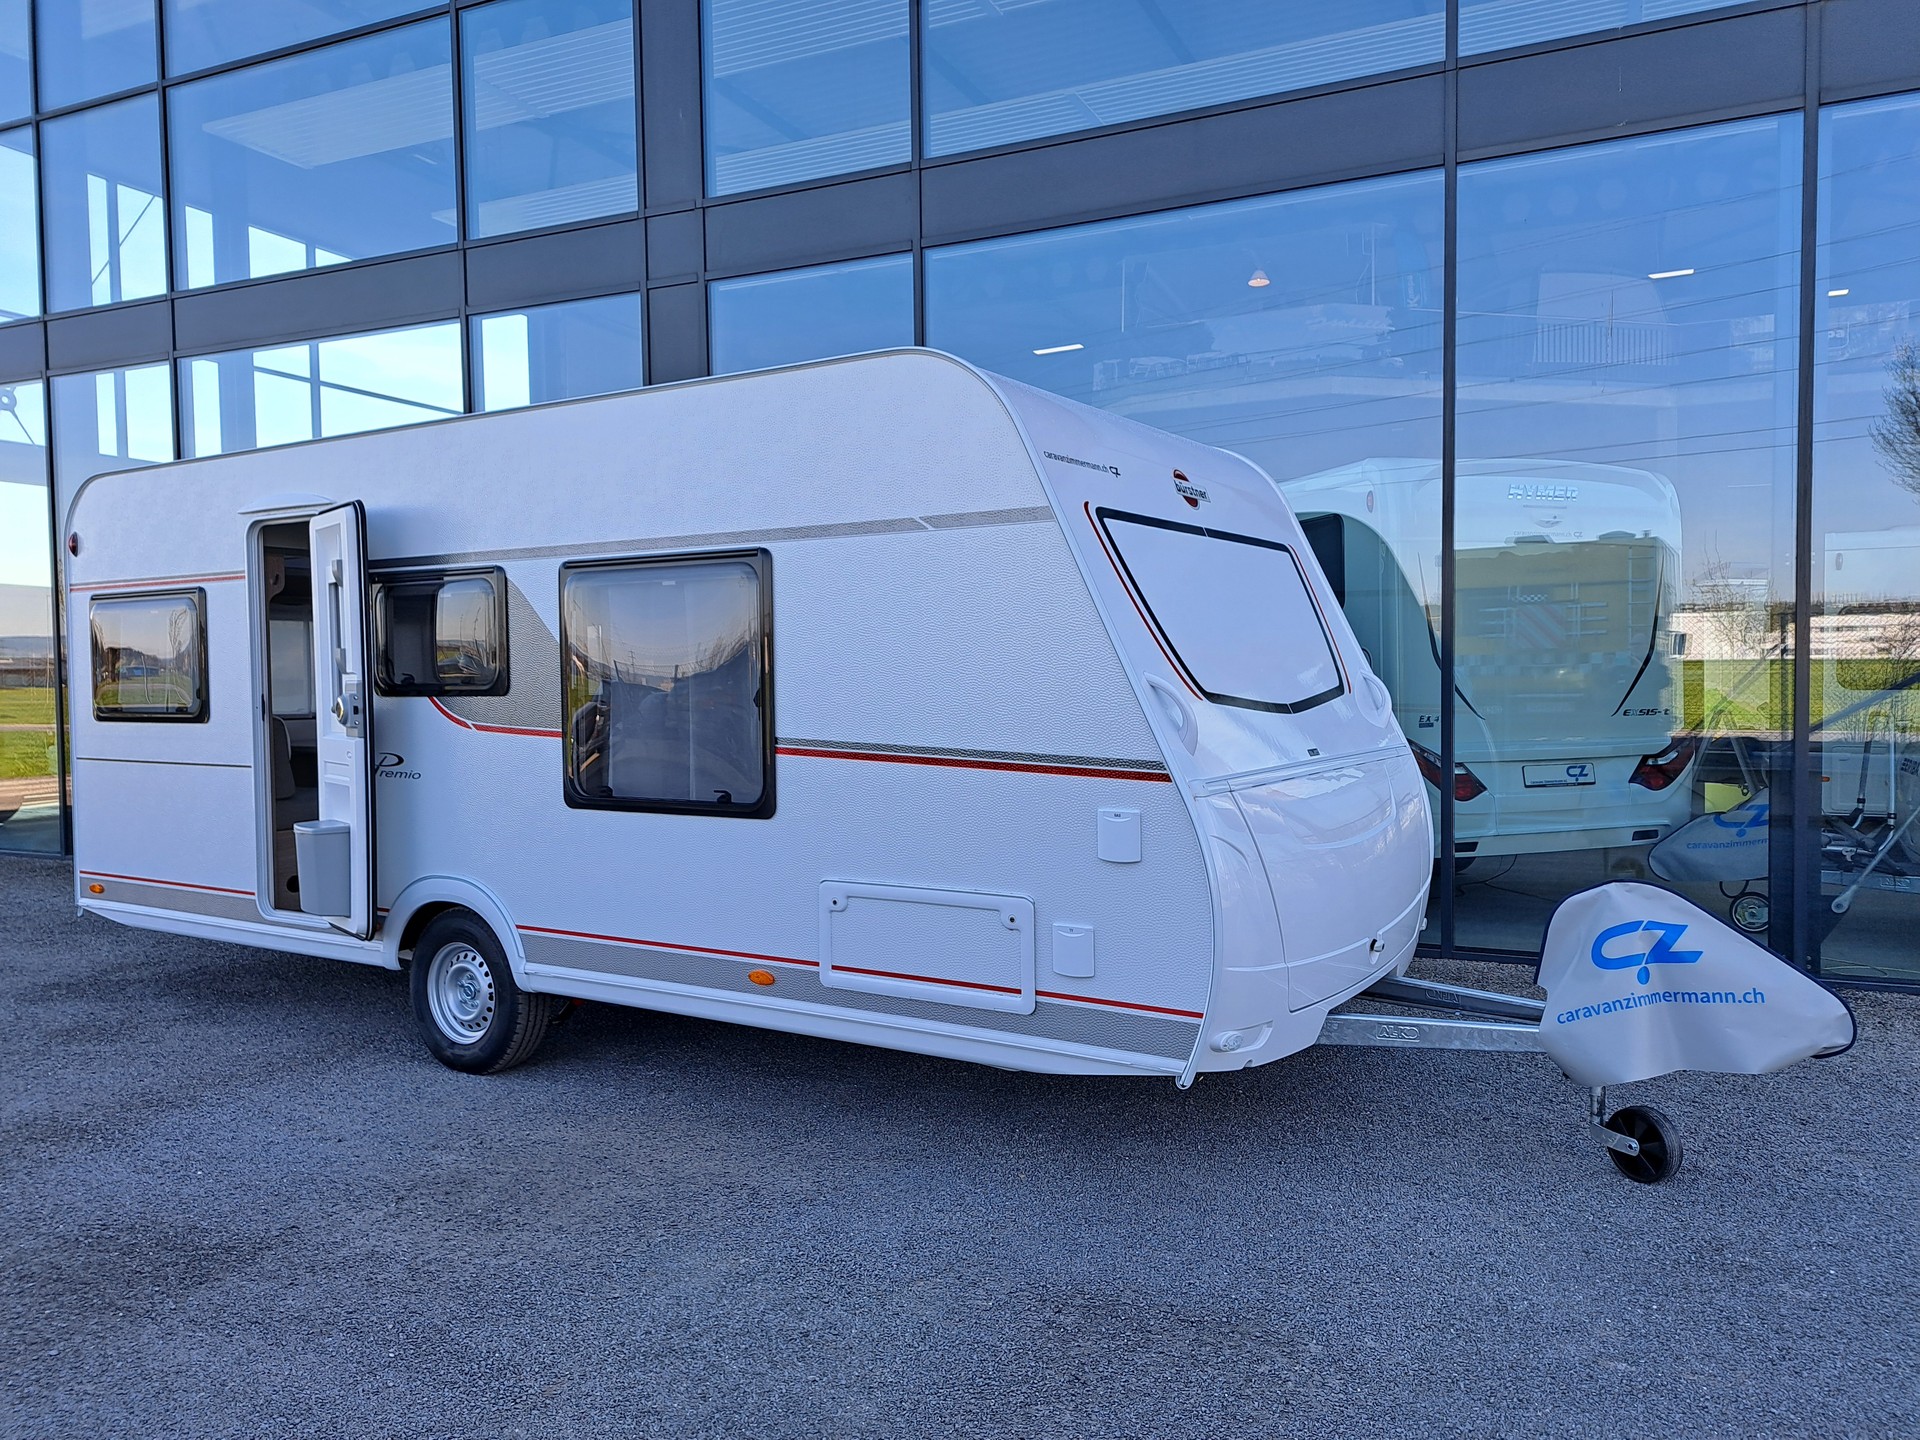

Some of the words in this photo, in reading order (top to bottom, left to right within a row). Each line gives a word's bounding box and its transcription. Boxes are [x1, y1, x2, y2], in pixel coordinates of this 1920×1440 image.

[1173, 480, 1208, 500] bürstner
[1507, 484, 1578, 500] HYMER
[375, 752, 422, 780] Premio
[1591, 920, 1703, 970] CZ
[1556, 987, 1766, 1025] caravanzimmermann.ch
